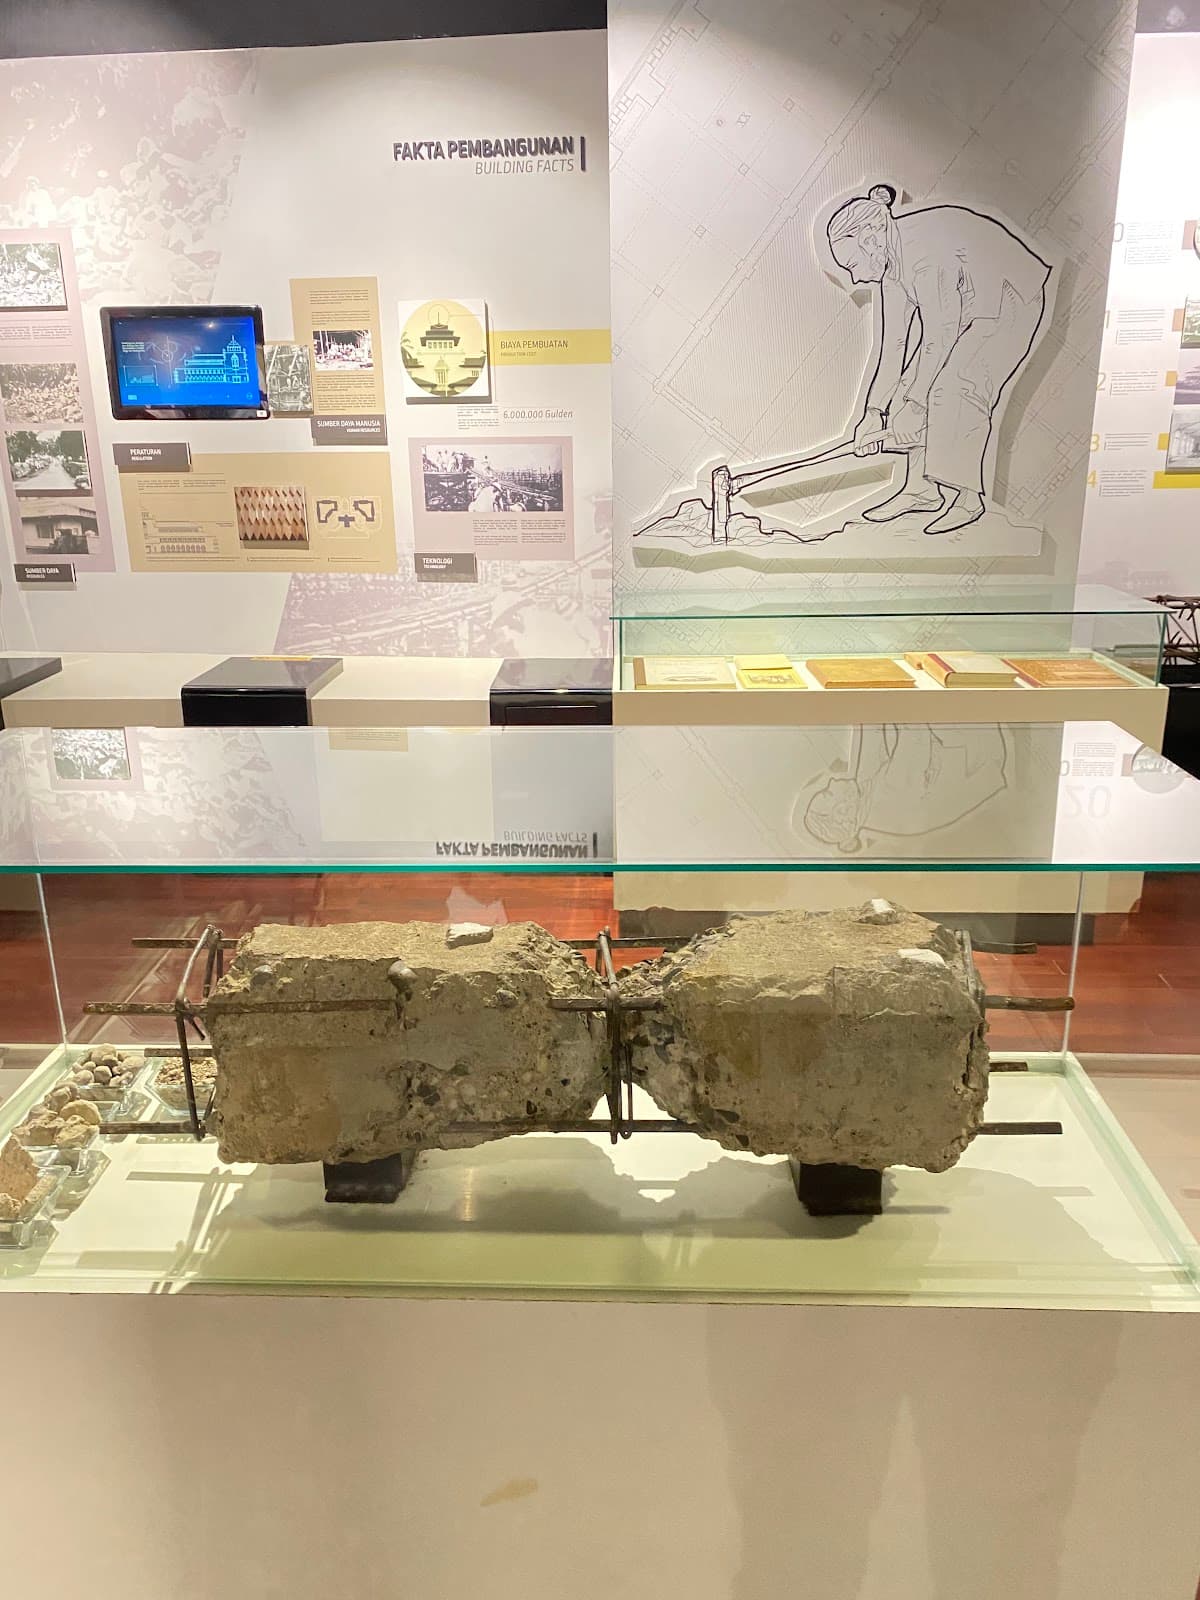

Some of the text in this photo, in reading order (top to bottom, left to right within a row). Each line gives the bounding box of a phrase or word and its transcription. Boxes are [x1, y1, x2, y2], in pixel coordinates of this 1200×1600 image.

[393, 136, 574, 161] FAKTA PEMBANGUNAN
[475, 158, 574, 174] BUILDING FACTS
[501, 340, 568, 349] BIAYA PEMBUATAN
[503, 409, 573, 419] 6.000.000 Gulden
[1087, 470, 1097, 488] 4
[423, 557, 453, 565] TEKNOLOGI
